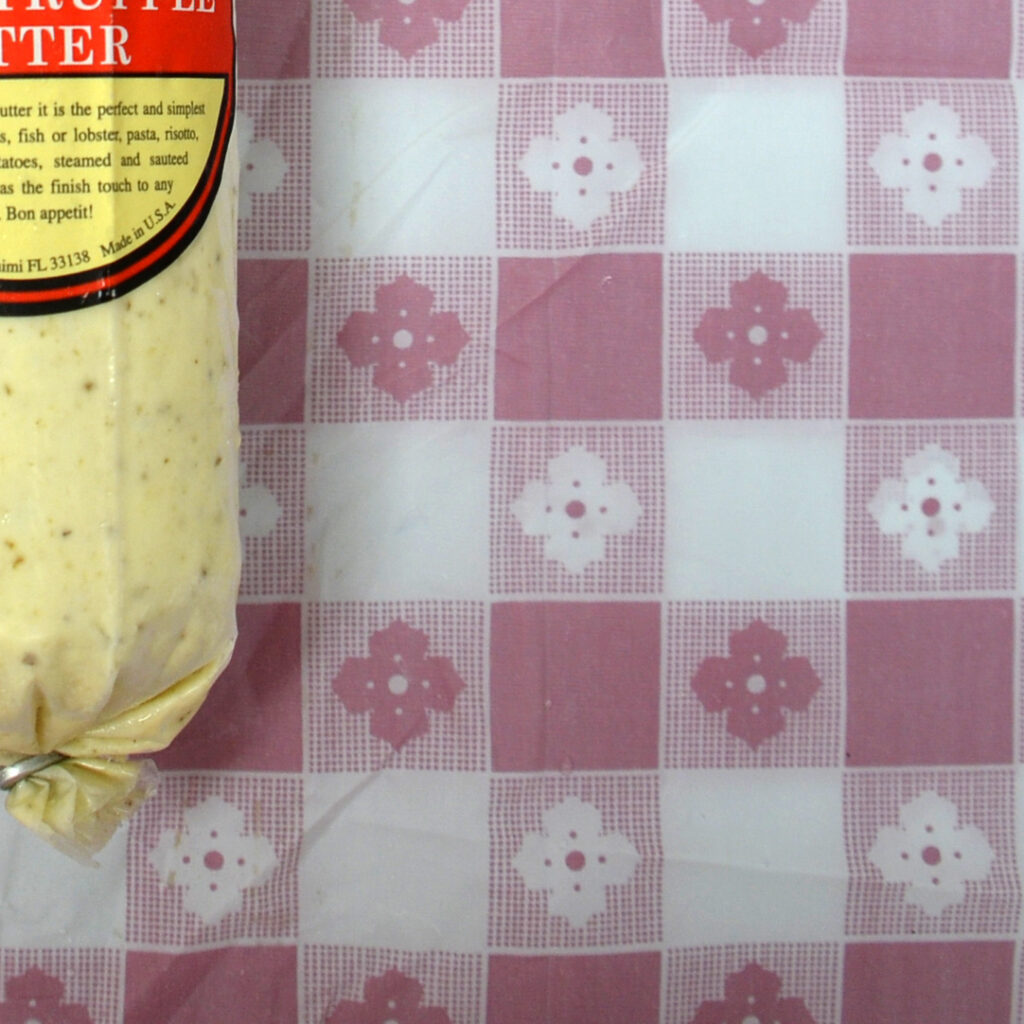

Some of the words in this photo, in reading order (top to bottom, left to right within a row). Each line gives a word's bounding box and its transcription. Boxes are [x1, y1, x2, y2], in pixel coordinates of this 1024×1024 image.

[38, 103, 48, 117] it
[54, 103, 65, 116] is
[71, 102, 92, 117] the
[97, 102, 138, 119] perfect
[143, 102, 163, 116] and
[167, 101, 206, 120] simplest
[18, 128, 45, 143] fish
[52, 131, 67, 143] or
[74, 127, 122, 144] lobster,
[127, 130, 160, 145] pasta,
[164, 128, 199, 142] risotto,
[54, 153, 111, 168] steamed
[121, 152, 140, 167] and
[149, 152, 188, 167] sauteed
[0, 183, 14, 194] as
[21, 180, 44, 195] the
[51, 178, 90, 194] finish
[98, 178, 132, 193] touch
[138, 180, 149, 192] to
[154, 179, 174, 193] any
[6, 206, 35, 221] Bon
[40, 204, 93, 223] appetit!
[100, 235, 133, 257] Made
[131, 227, 145, 240] in
[27, 258, 48, 272] FL
[50, 250, 90, 271] 33138
